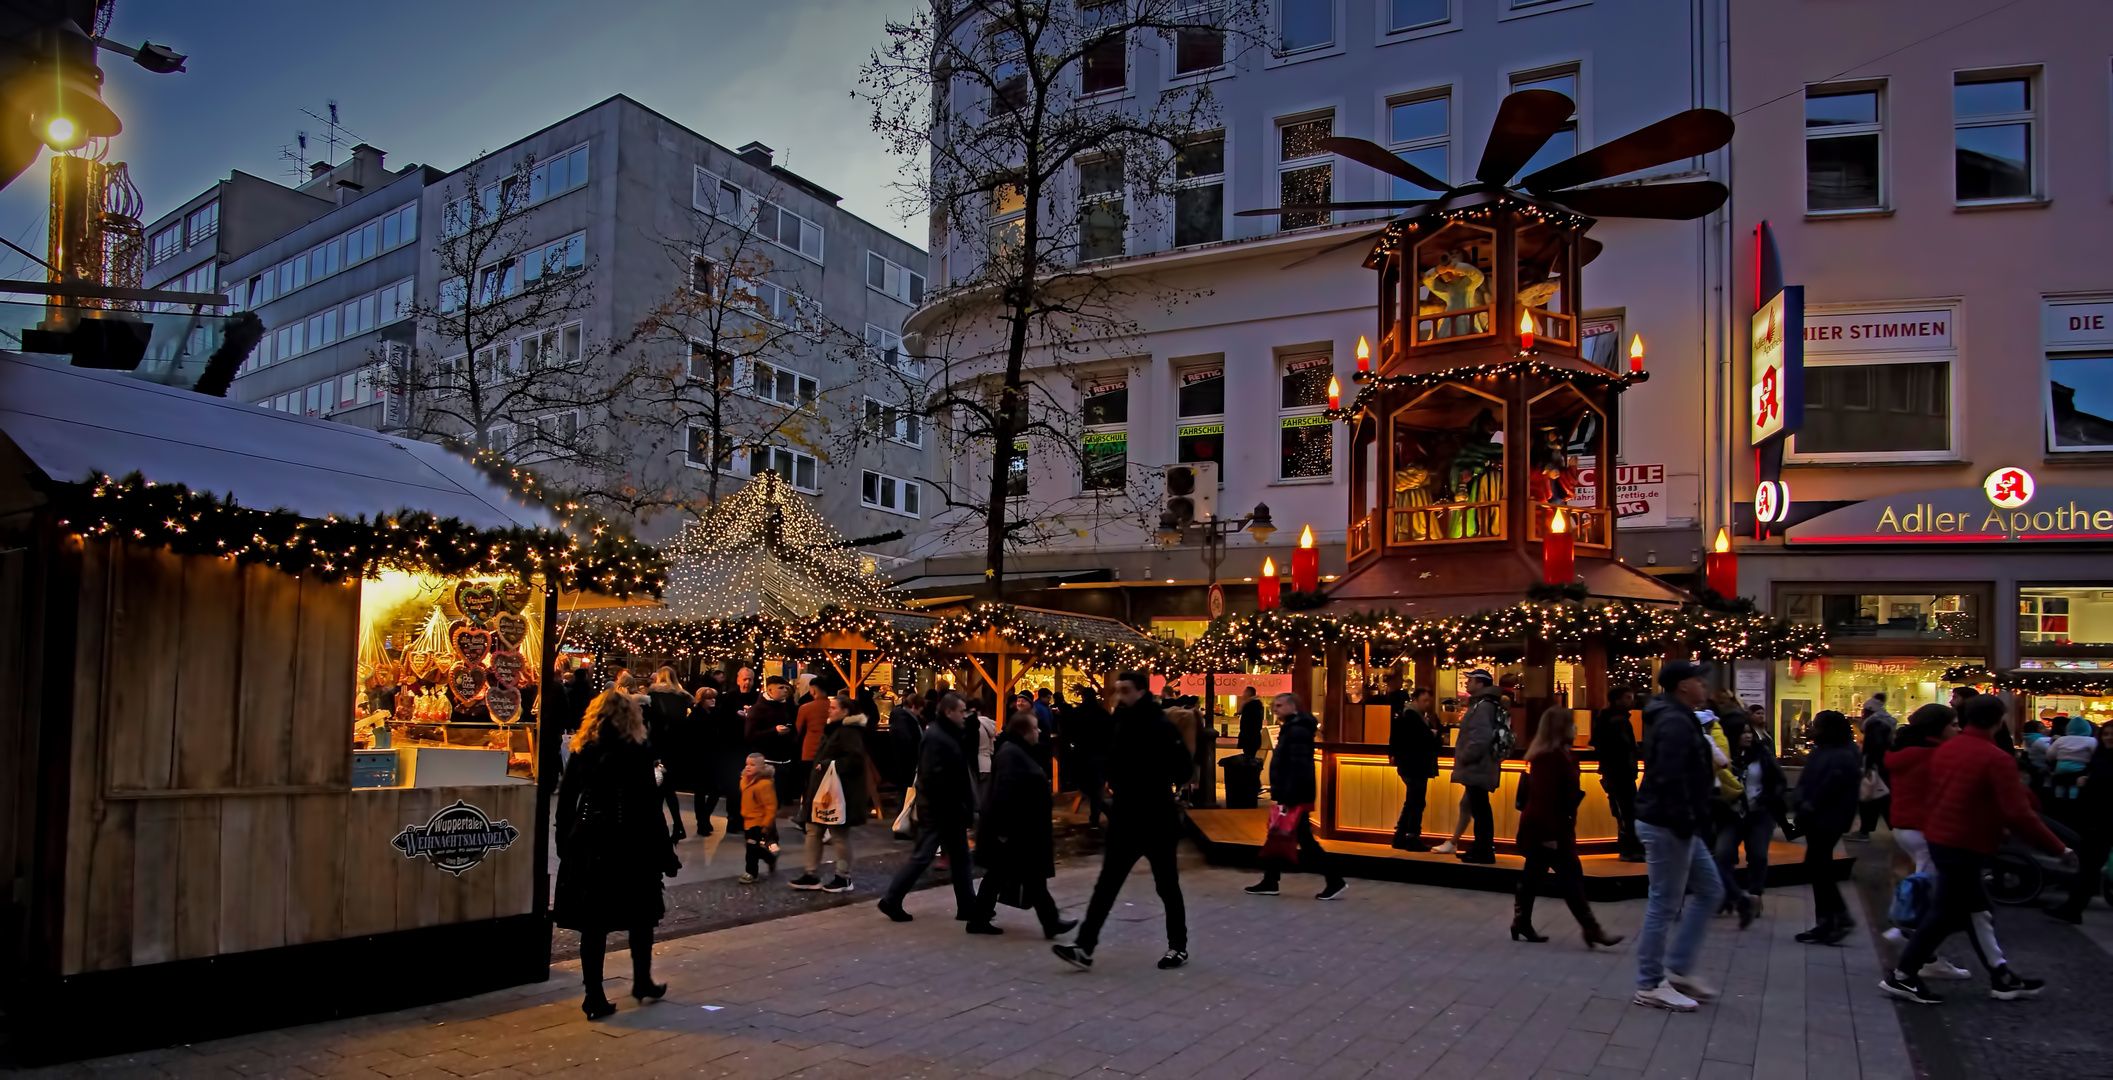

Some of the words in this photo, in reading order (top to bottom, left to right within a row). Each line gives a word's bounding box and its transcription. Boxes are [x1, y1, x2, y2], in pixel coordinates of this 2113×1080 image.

[1850, 321, 1945, 339] STIMMEN
[2069, 315, 2104, 331] DIE
[1875, 503, 1971, 533] Adler
[1981, 501, 2113, 540] Apothe
[434, 816, 484, 834] Wuppertaler
